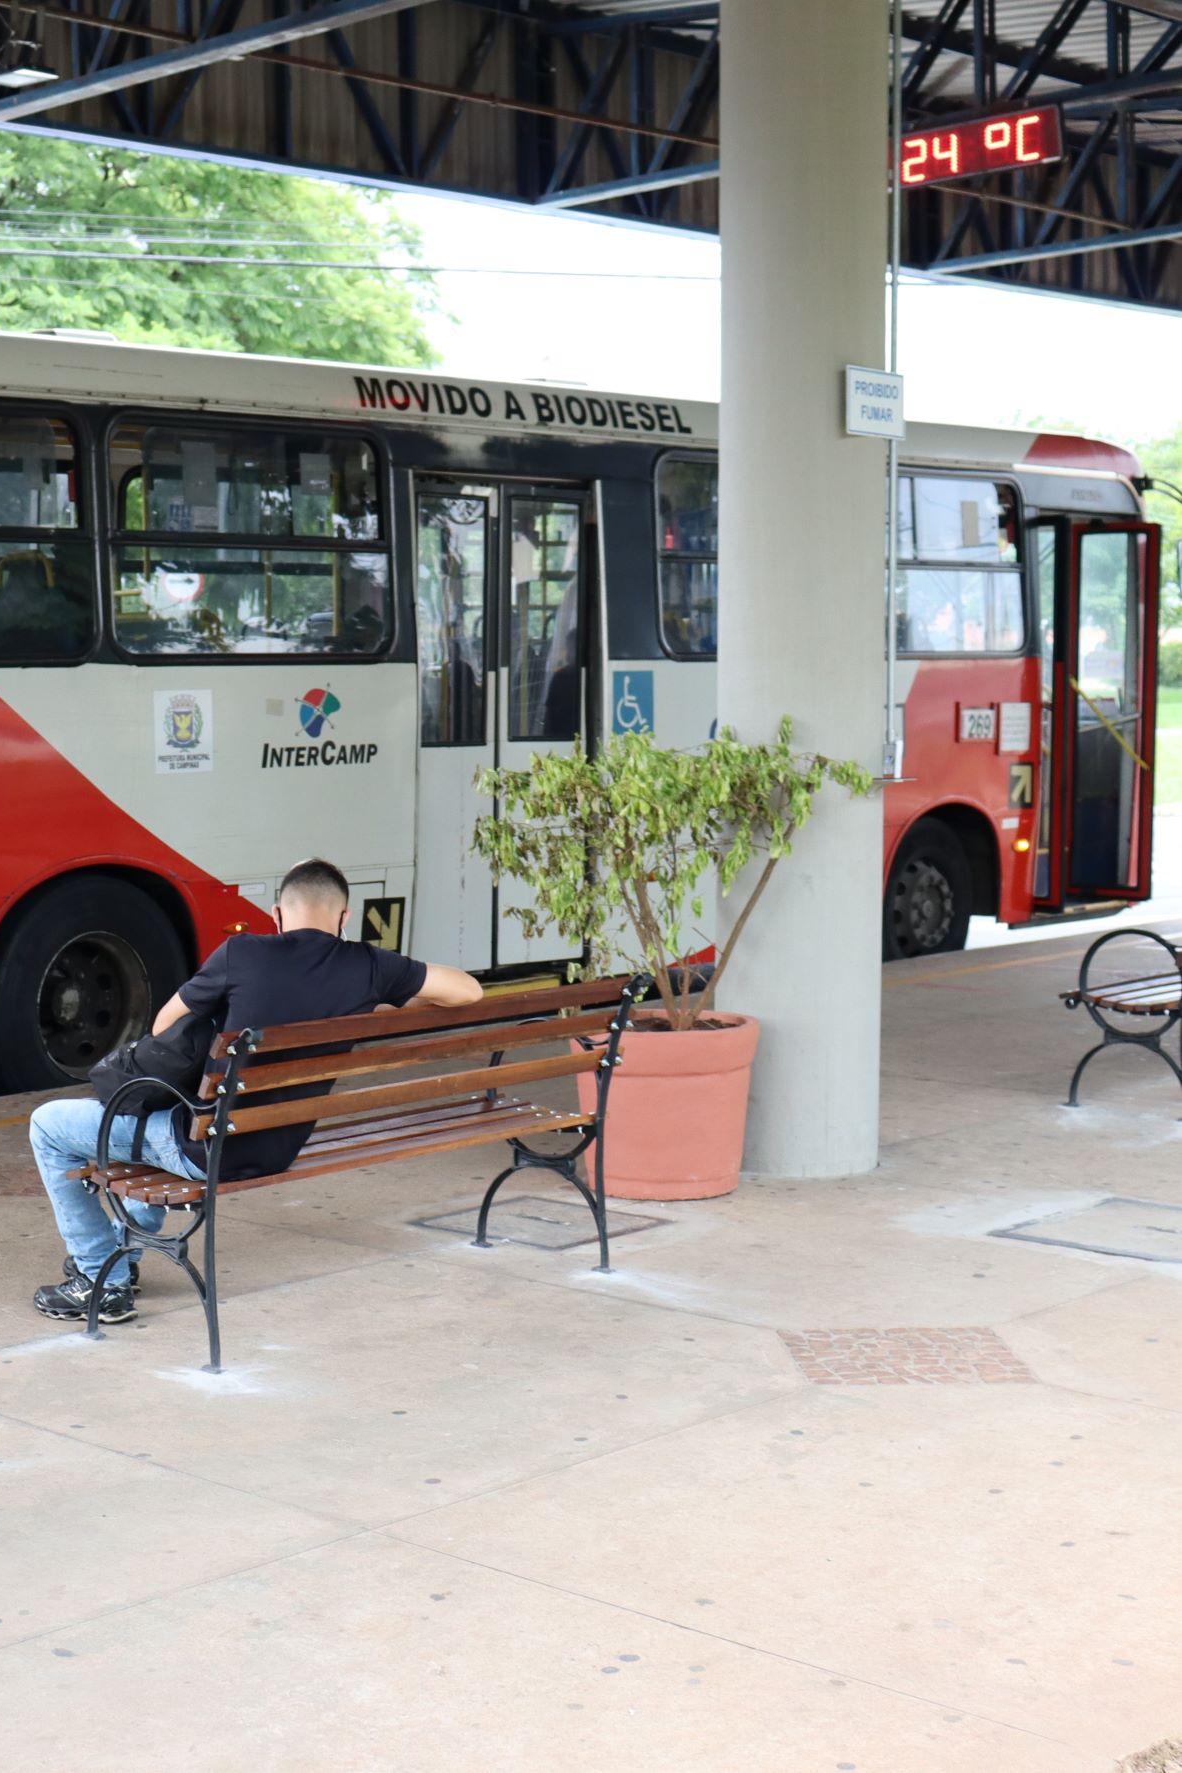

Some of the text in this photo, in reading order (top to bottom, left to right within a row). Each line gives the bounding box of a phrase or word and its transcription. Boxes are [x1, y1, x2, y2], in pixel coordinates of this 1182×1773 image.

[902, 133, 958, 183] 24
[854, 380, 899, 400] PROIBIDO
[353, 376, 693, 434] MOVIDO A BIODIESEL
[860, 404, 894, 423] FUMAR
[967, 714, 992, 738] 269
